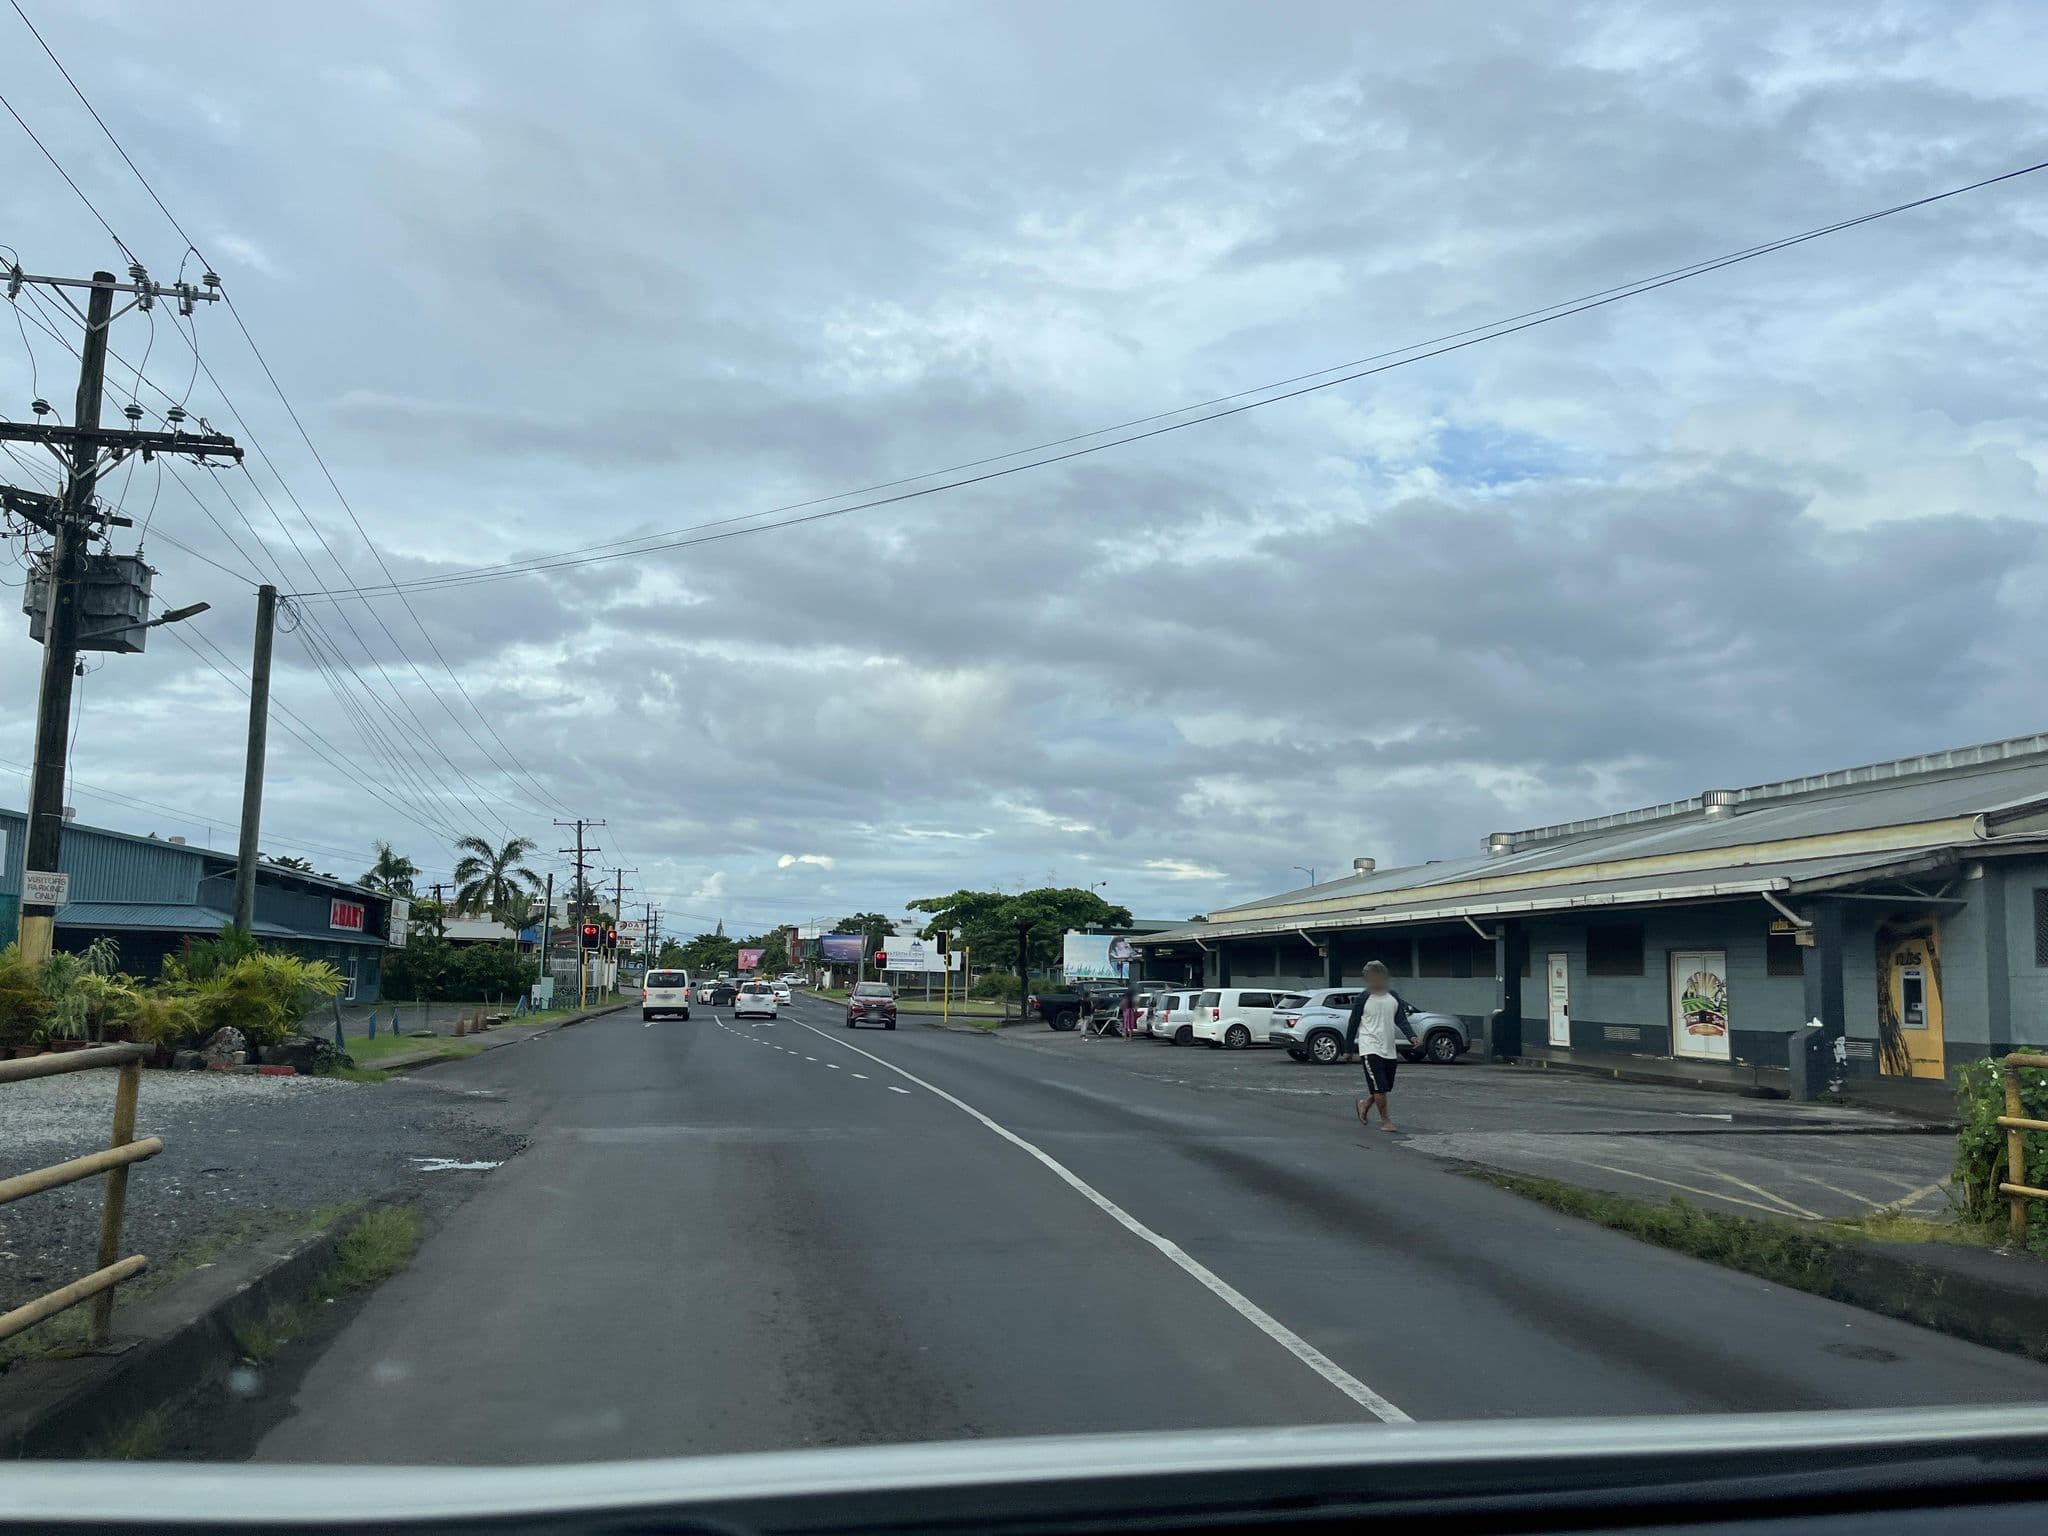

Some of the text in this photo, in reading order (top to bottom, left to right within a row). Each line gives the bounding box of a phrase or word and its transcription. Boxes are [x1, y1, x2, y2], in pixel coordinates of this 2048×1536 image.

[27, 876, 65, 886] VISITORS
[27, 884, 64, 893] PARKING
[34, 892, 55, 900] ONLY
